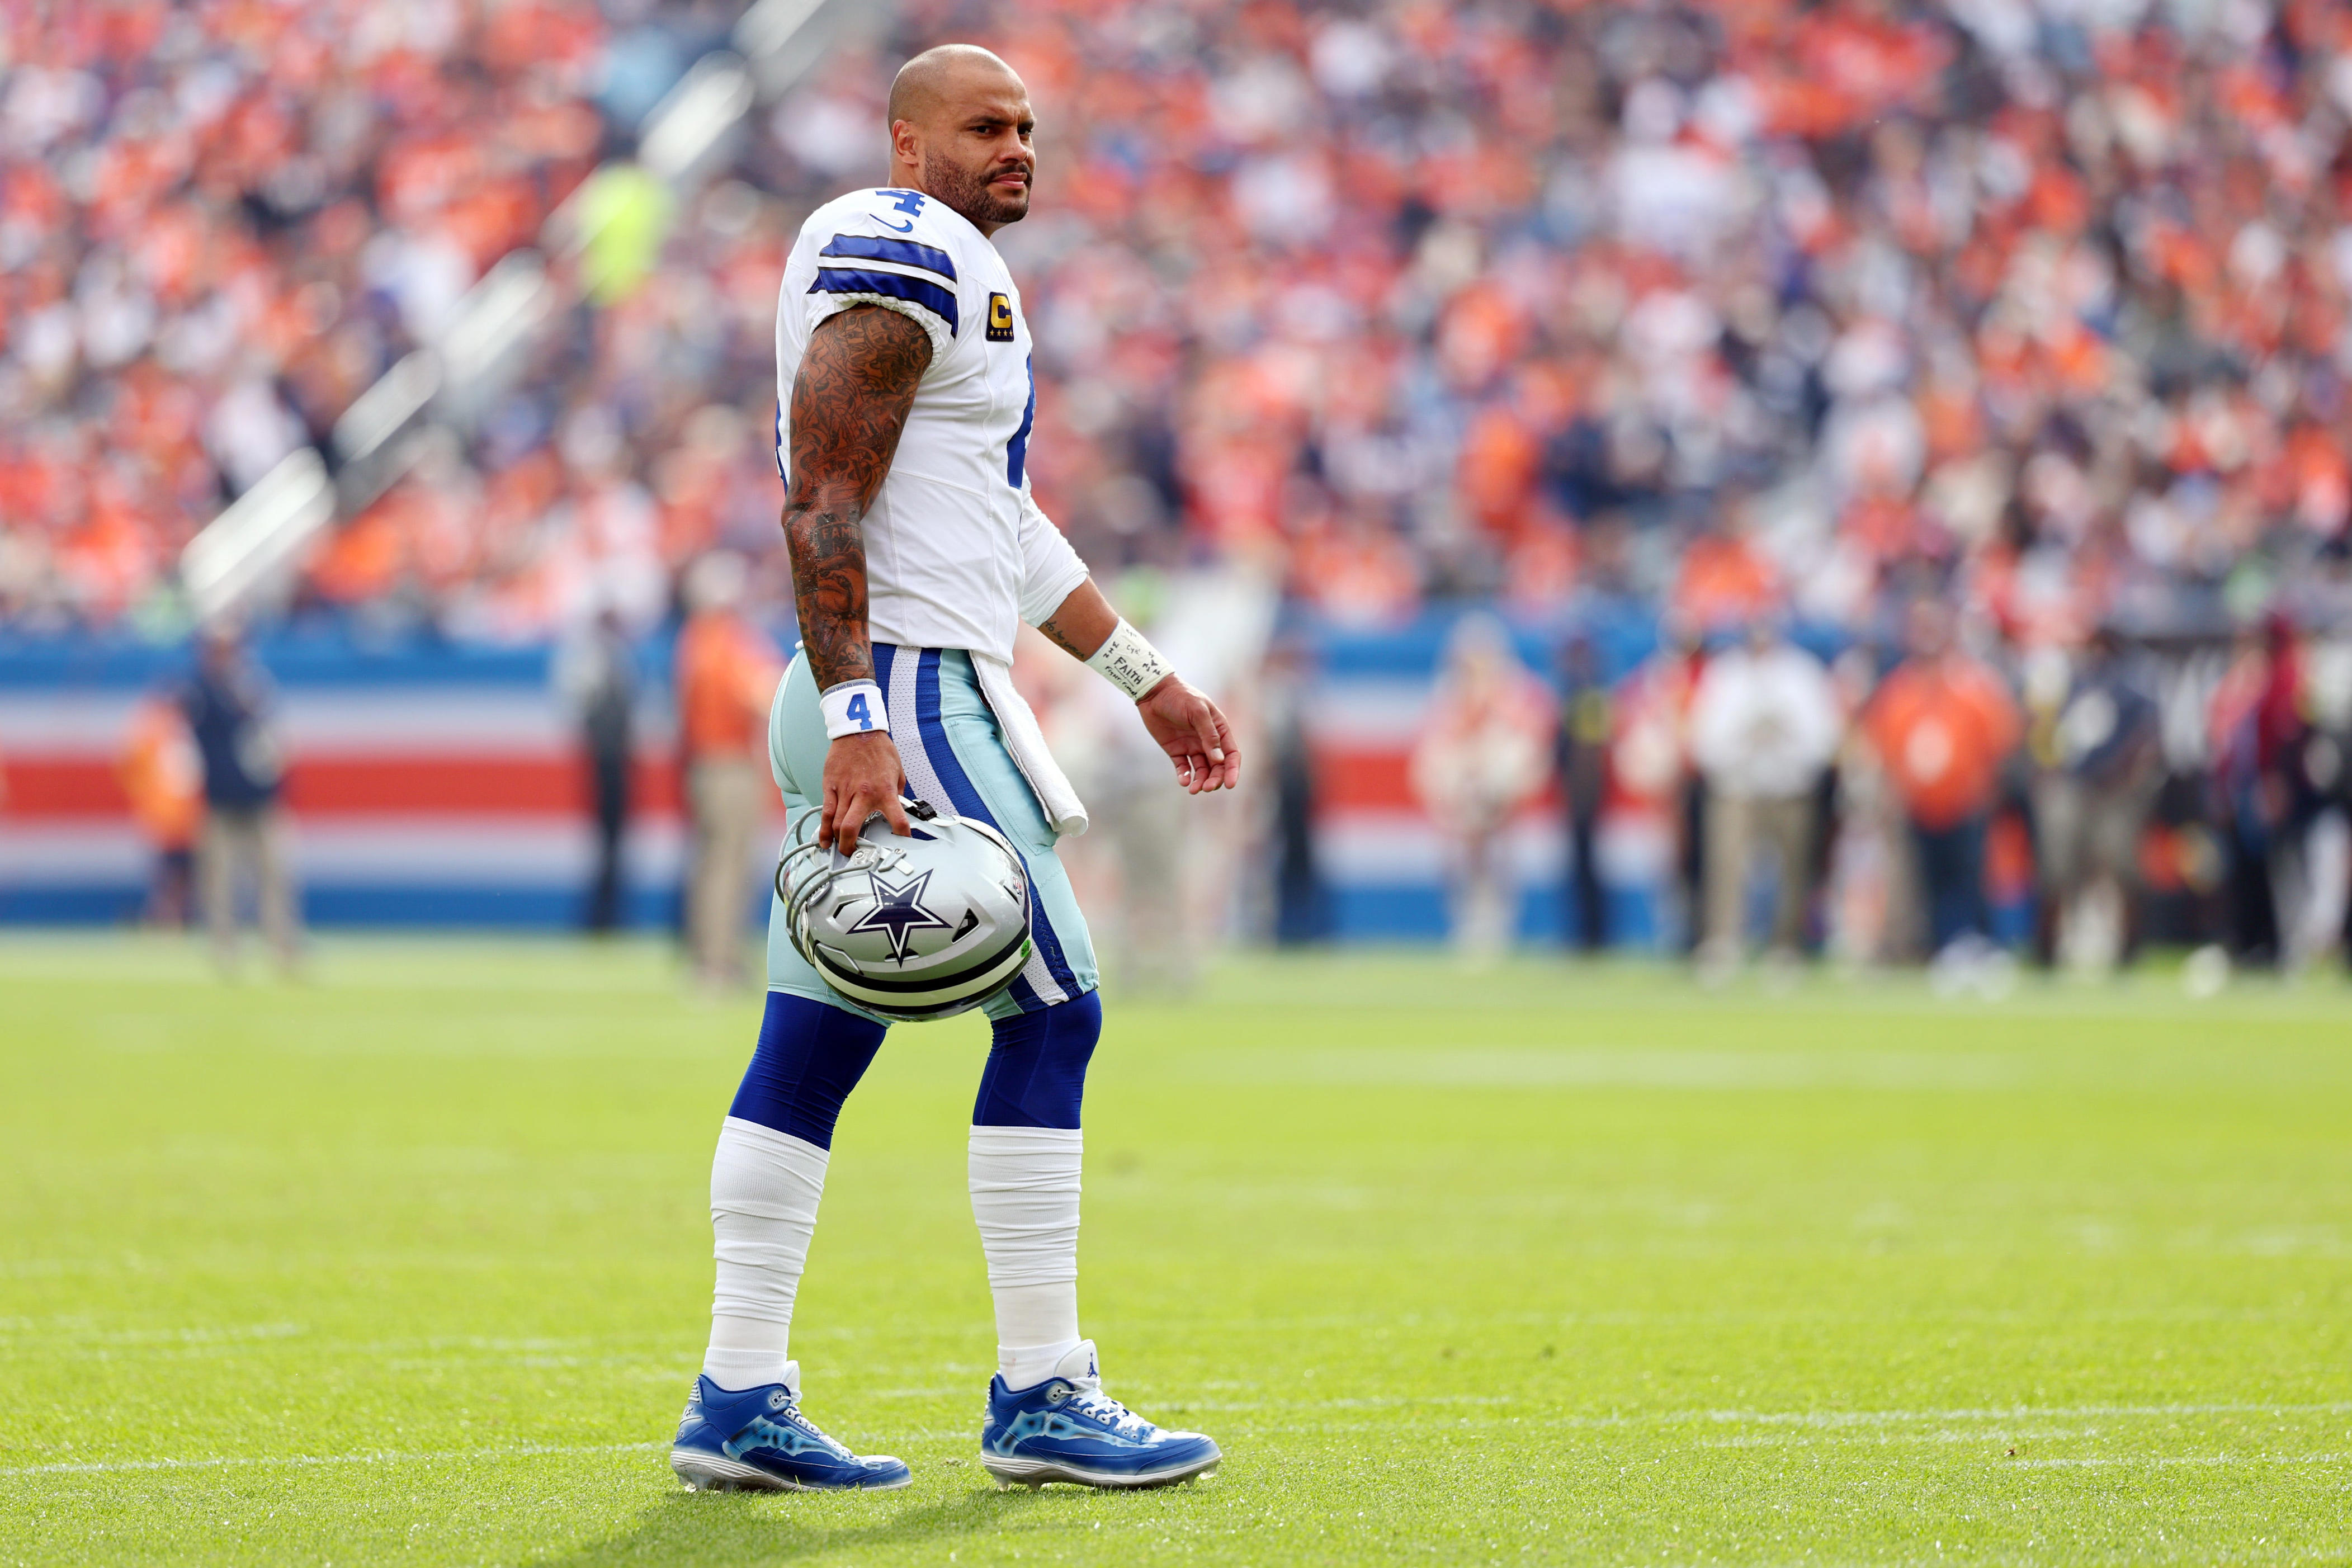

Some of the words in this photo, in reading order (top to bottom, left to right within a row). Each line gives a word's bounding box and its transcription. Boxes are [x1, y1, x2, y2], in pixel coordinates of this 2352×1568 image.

[875, 190, 925, 218] 4
[990, 295, 1012, 329] C
[821, 526, 859, 540] FAMIL
[1114, 657, 1144, 684] FAITH
[846, 693, 873, 730] 4
